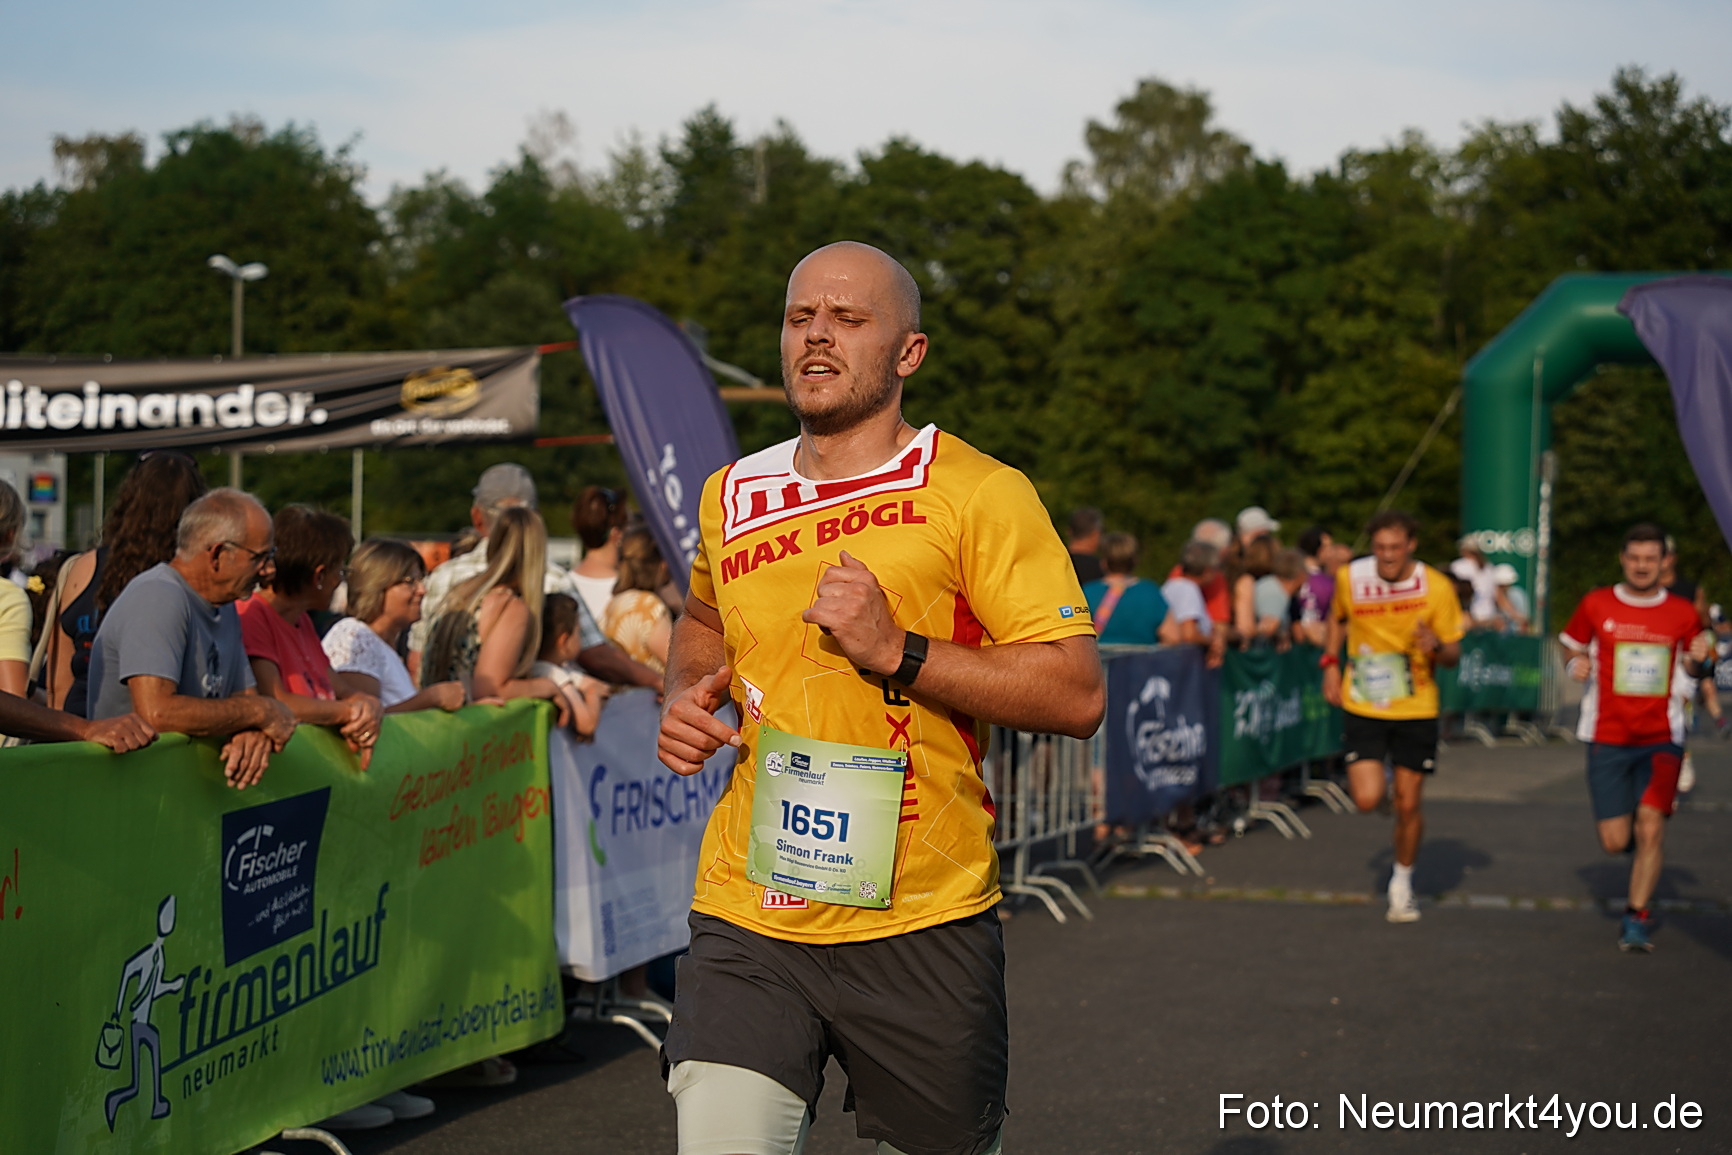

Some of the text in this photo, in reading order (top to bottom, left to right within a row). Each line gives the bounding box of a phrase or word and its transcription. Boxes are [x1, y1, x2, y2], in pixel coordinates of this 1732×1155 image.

[0, 379, 328, 429] iteinander.
[720, 500, 927, 585] MAX BÖGL
[784, 766, 826, 780] Firmenlauf
[612, 764, 735, 836] FRISCHM
[781, 799, 850, 843] 1651
[238, 840, 307, 881] Fischer
[776, 838, 854, 866] Simon Frank
[243, 865, 299, 895] AUTOMOBILE
[179, 882, 389, 1058] firmenlauf
[184, 1024, 279, 1099] neumarkt
